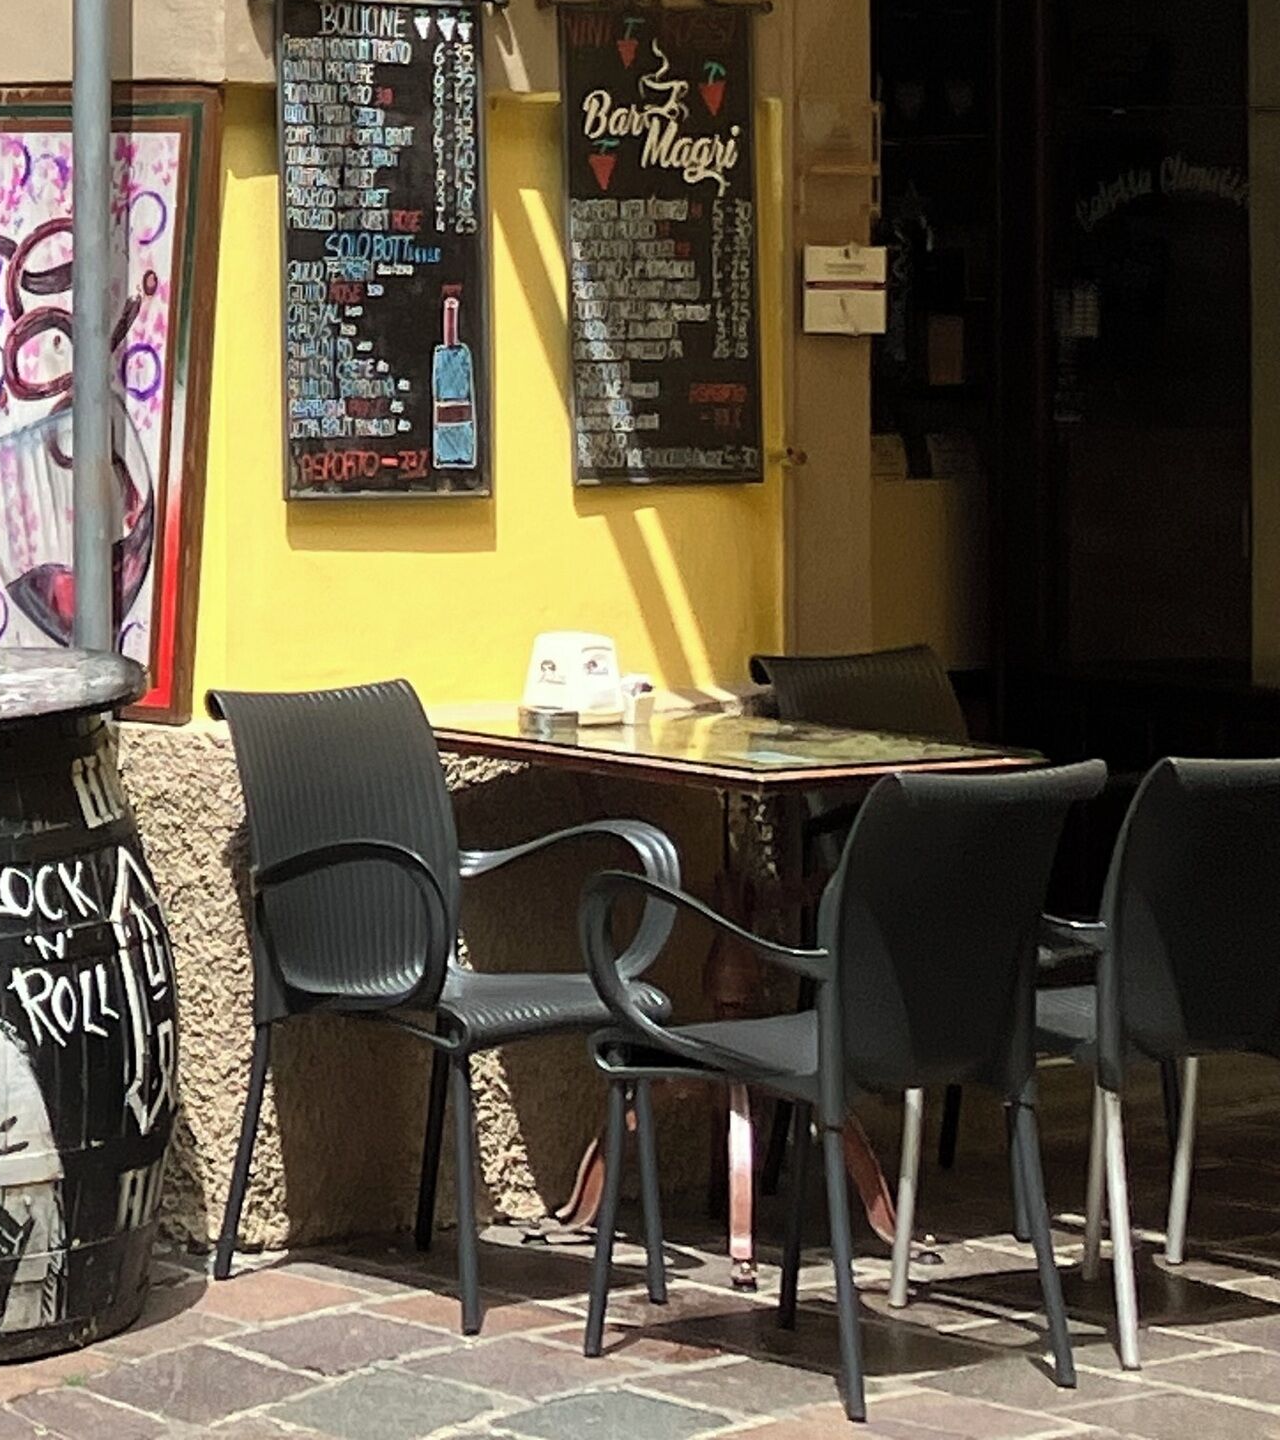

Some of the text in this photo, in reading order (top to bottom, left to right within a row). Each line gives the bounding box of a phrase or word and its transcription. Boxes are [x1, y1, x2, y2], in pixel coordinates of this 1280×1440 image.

[583, 90, 643, 137] Bar
[641, 117, 742, 196] Magri
[6, 962, 121, 1048] ROLL
